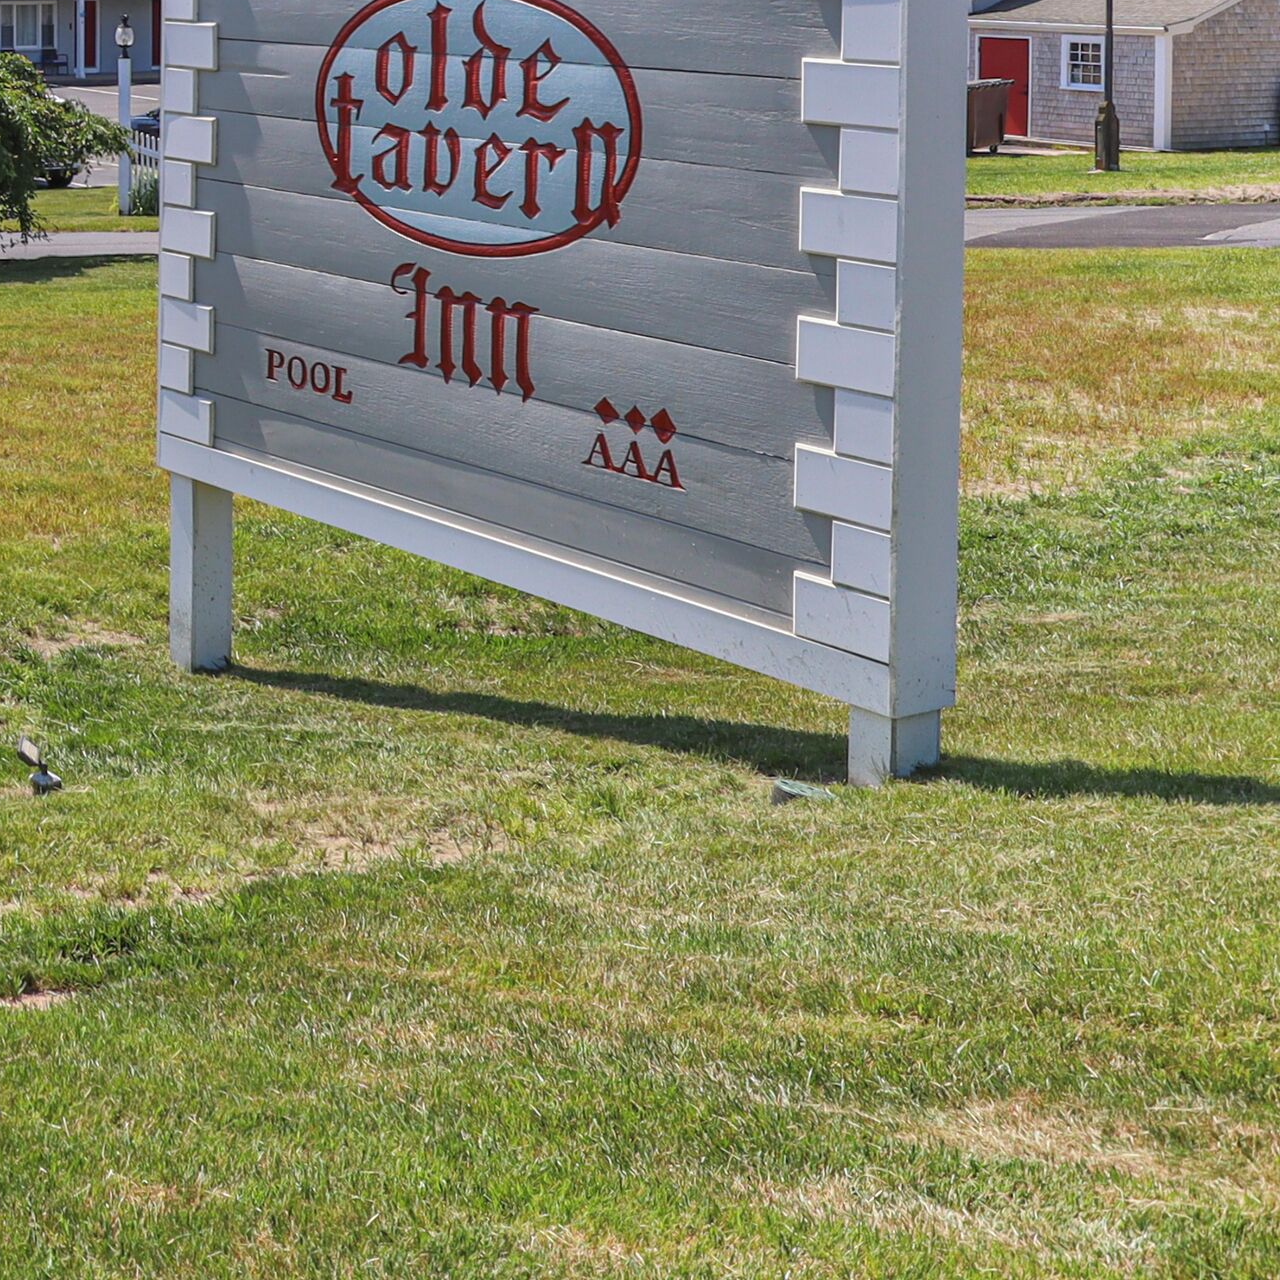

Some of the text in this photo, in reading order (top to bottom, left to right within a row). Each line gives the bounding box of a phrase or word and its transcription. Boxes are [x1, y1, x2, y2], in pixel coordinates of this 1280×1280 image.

[375, 0, 571, 122] olde
[329, 73, 625, 231] tavern
[264, 348, 353, 405] POOL
[391, 261, 540, 403] Inn
[582, 433, 685, 489] AAA
